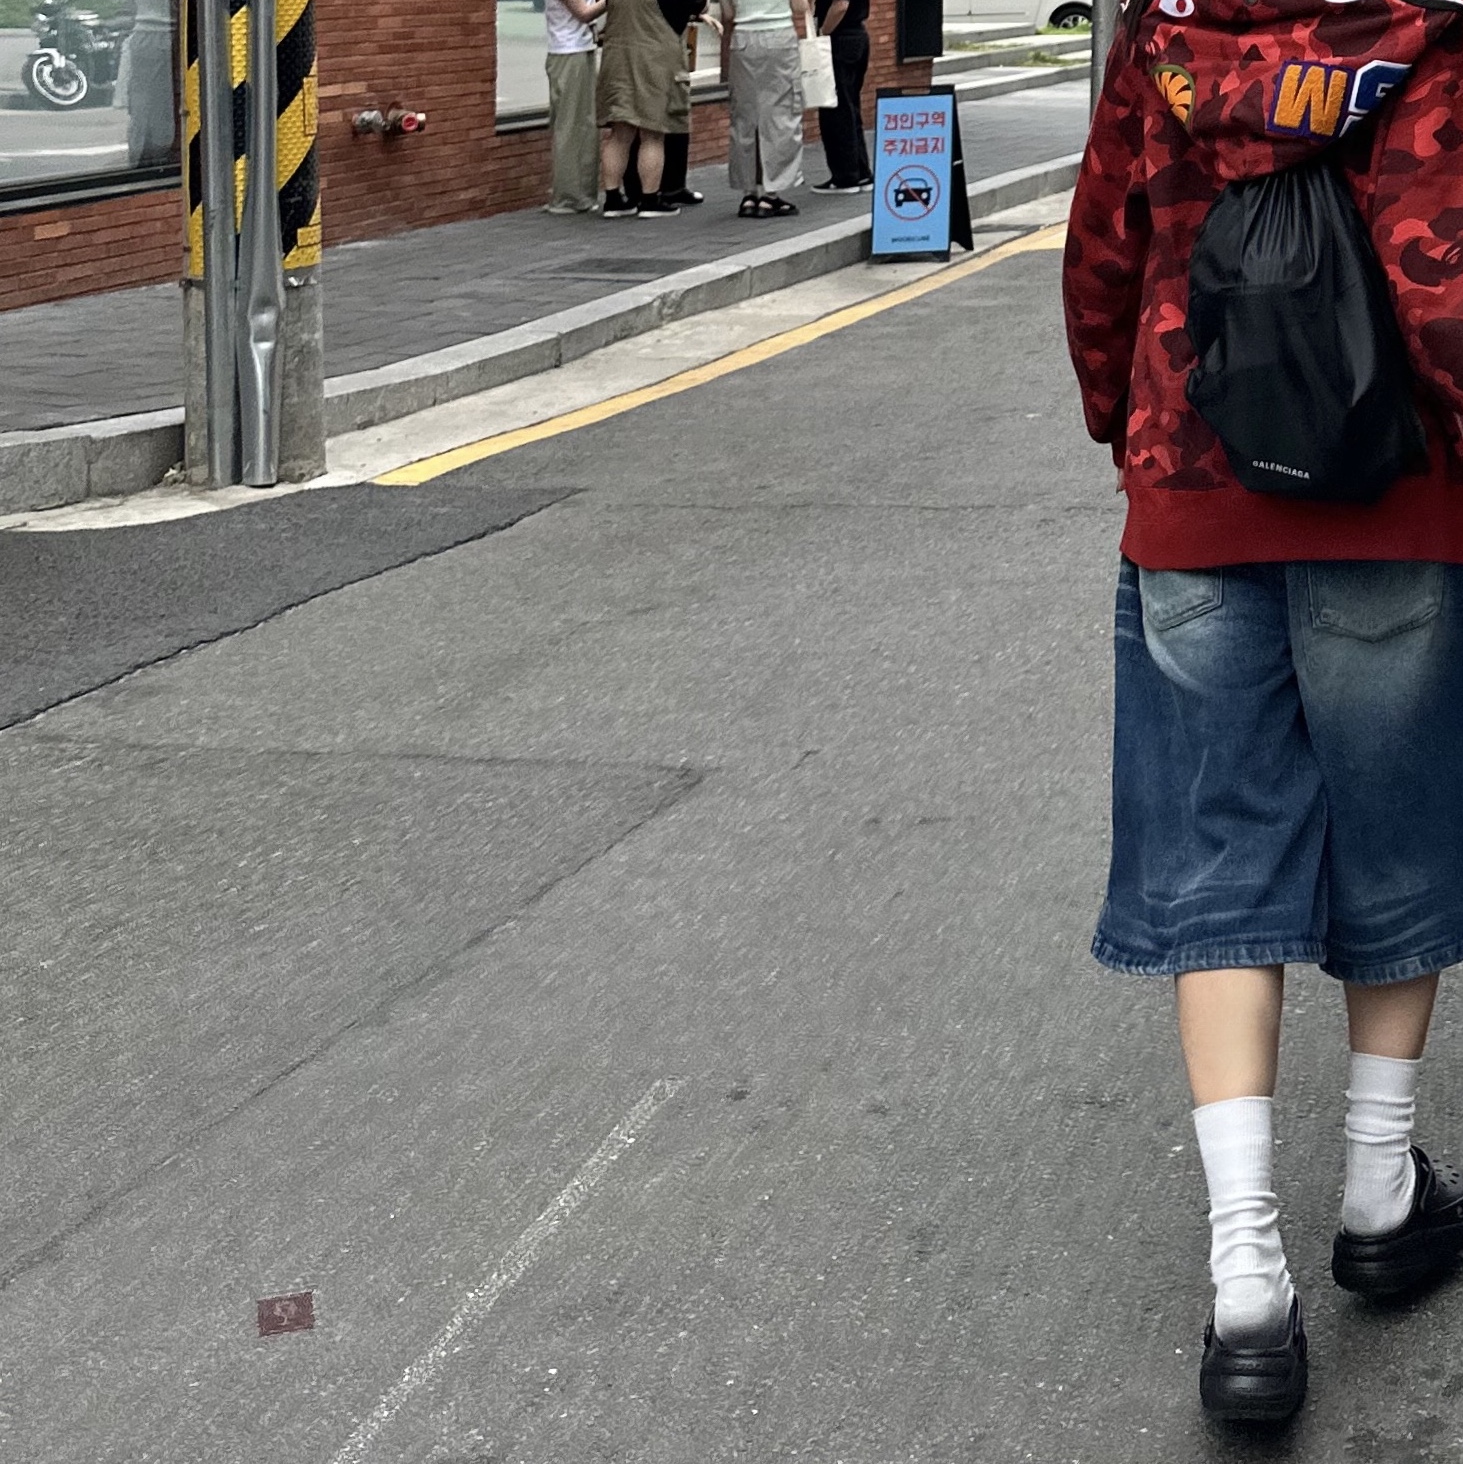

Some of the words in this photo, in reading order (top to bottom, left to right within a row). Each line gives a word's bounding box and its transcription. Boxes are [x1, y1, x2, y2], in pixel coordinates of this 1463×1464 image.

[883, 111, 946, 131] 견인구역
[883, 137, 945, 156] 주차금지
[1252, 460, 1311, 480] BALENCIAGA
